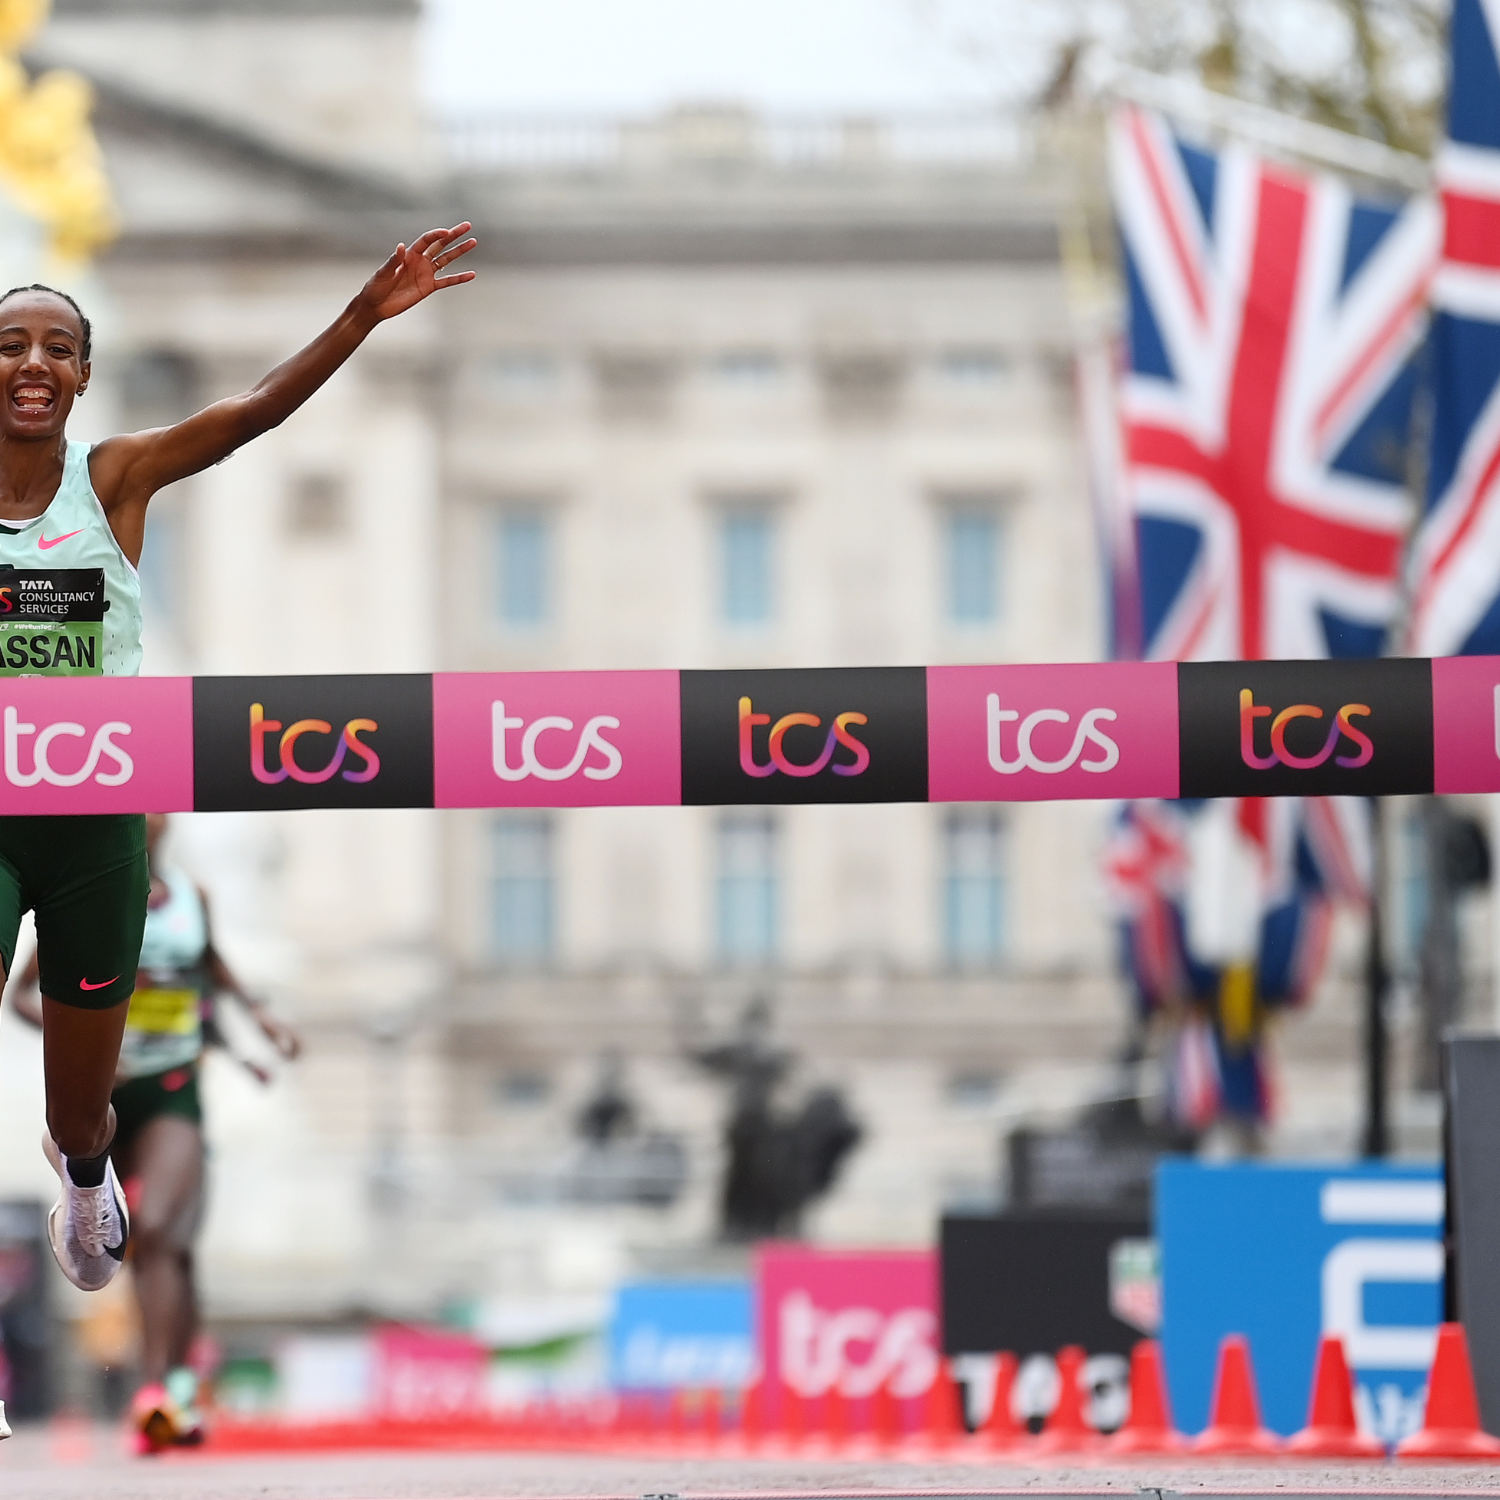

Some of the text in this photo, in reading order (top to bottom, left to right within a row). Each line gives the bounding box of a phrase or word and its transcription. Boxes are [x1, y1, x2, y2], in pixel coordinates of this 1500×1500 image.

[19, 580, 54, 590] TATA
[19, 591, 96, 603] CONSULTANCY
[19, 604, 70, 615] SERVICES
[13, 623, 67, 632] #WeRunToger
[5, 706, 133, 787] tcs
[250, 703, 380, 784] tcs
[491, 701, 622, 781] tcs
[738, 696, 870, 778] tcs
[987, 693, 1119, 774] tcs
[1239, 689, 1374, 770] tcs
[777, 1290, 939, 1398] tcs
